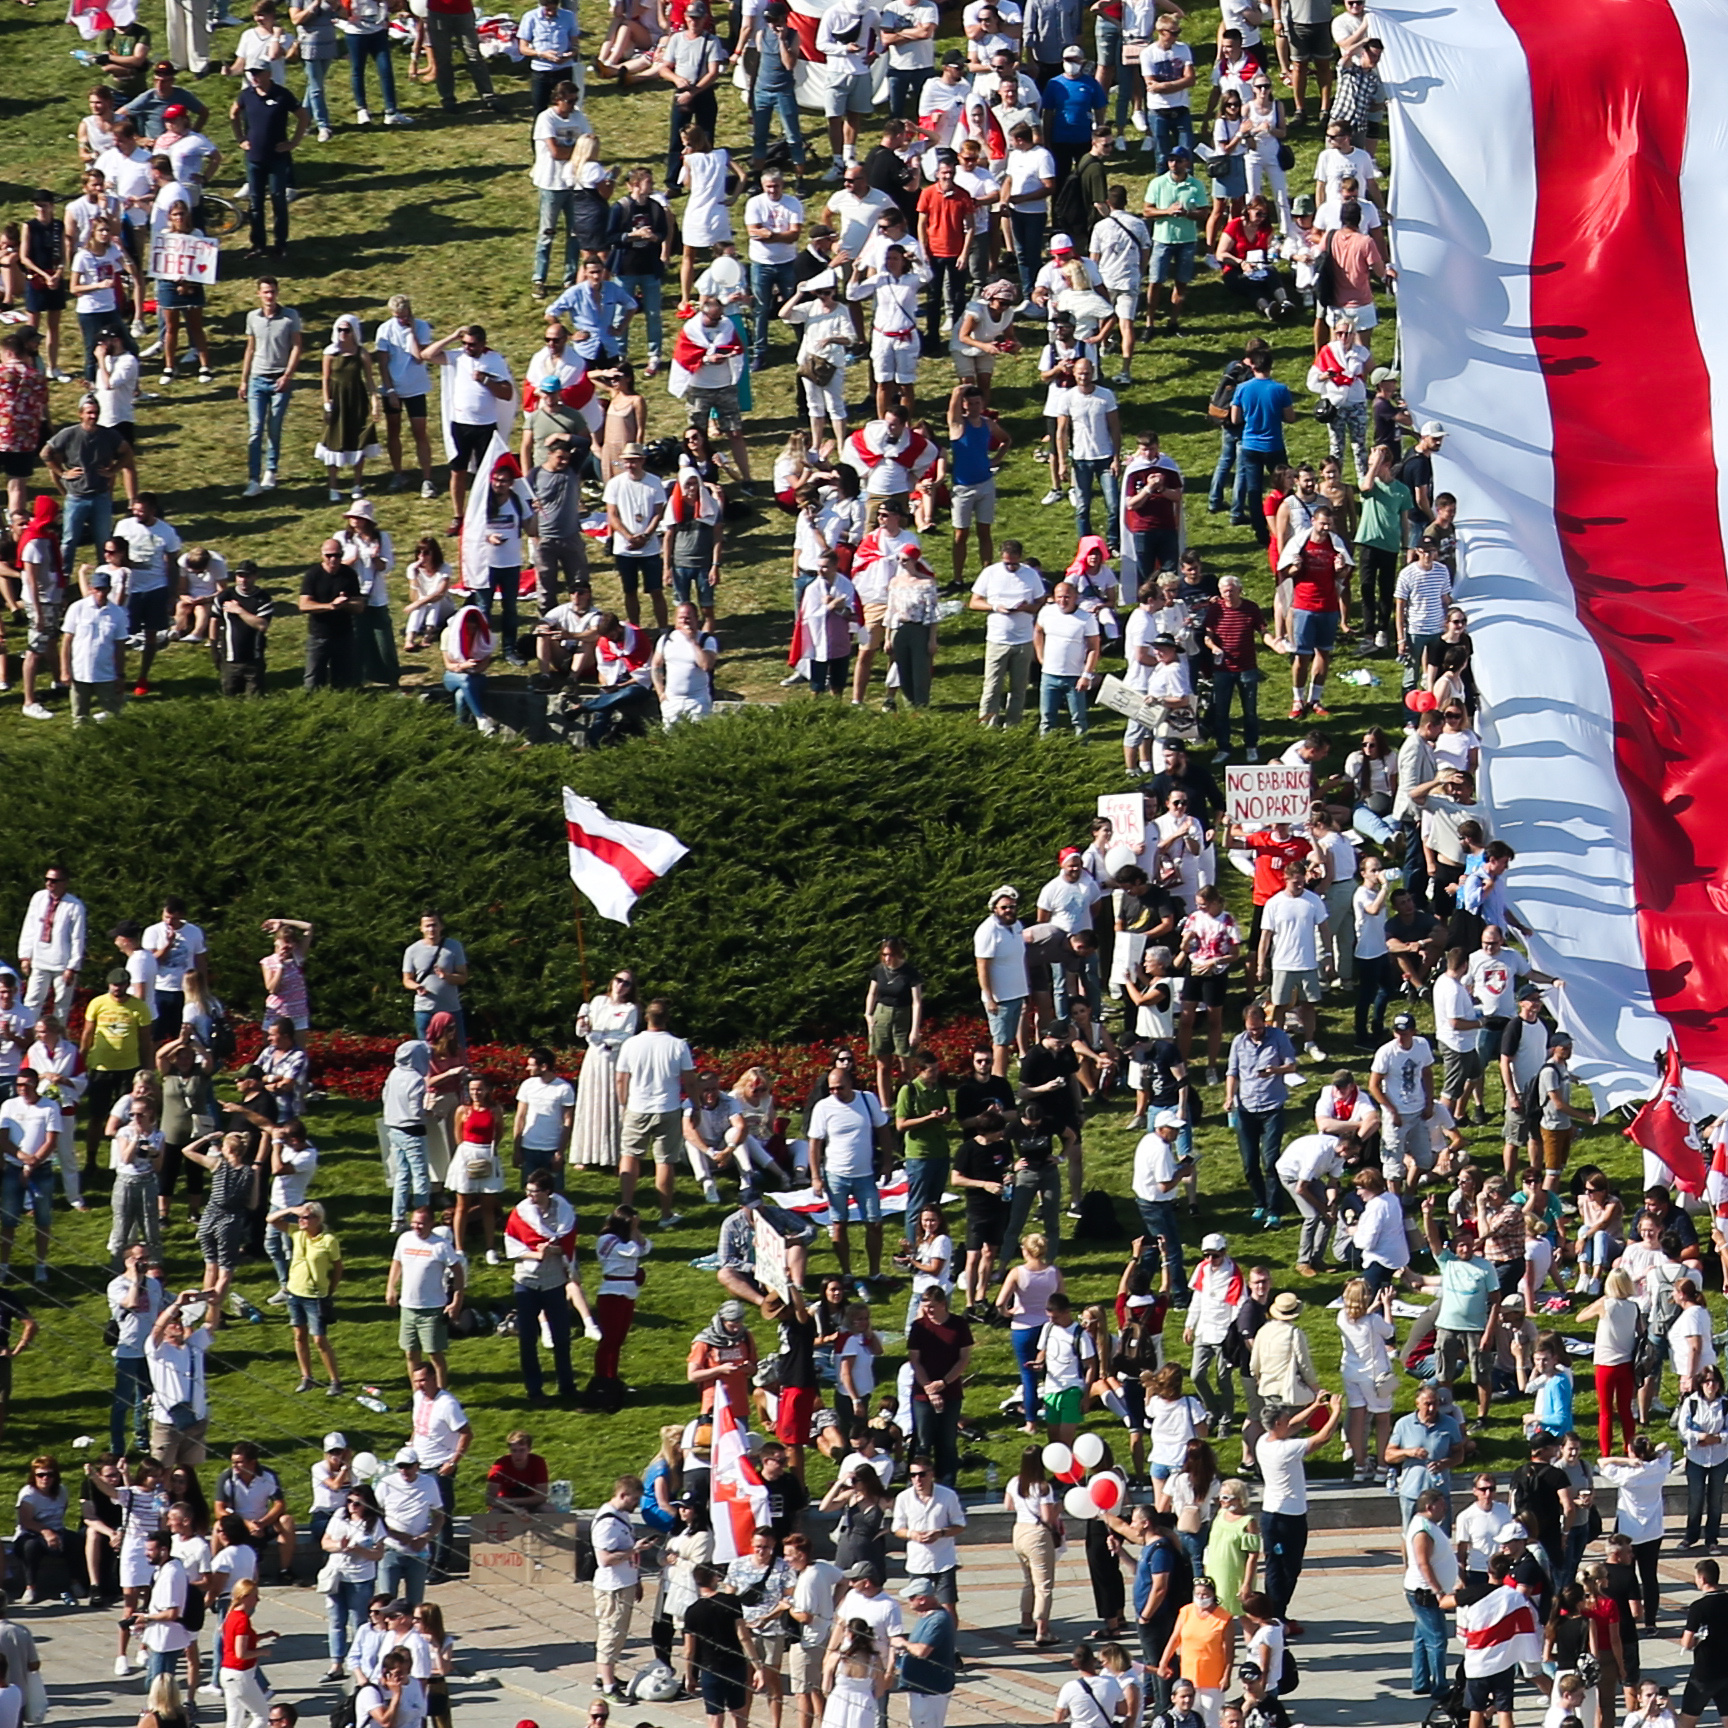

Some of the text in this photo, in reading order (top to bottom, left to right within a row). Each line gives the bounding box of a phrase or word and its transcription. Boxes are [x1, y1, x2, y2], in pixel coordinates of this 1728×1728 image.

[1228, 773, 1252, 792] NO
[1235, 794, 1308, 820] NO PARTY
[473, 1552, 524, 1567] СЛОМИТЬ
